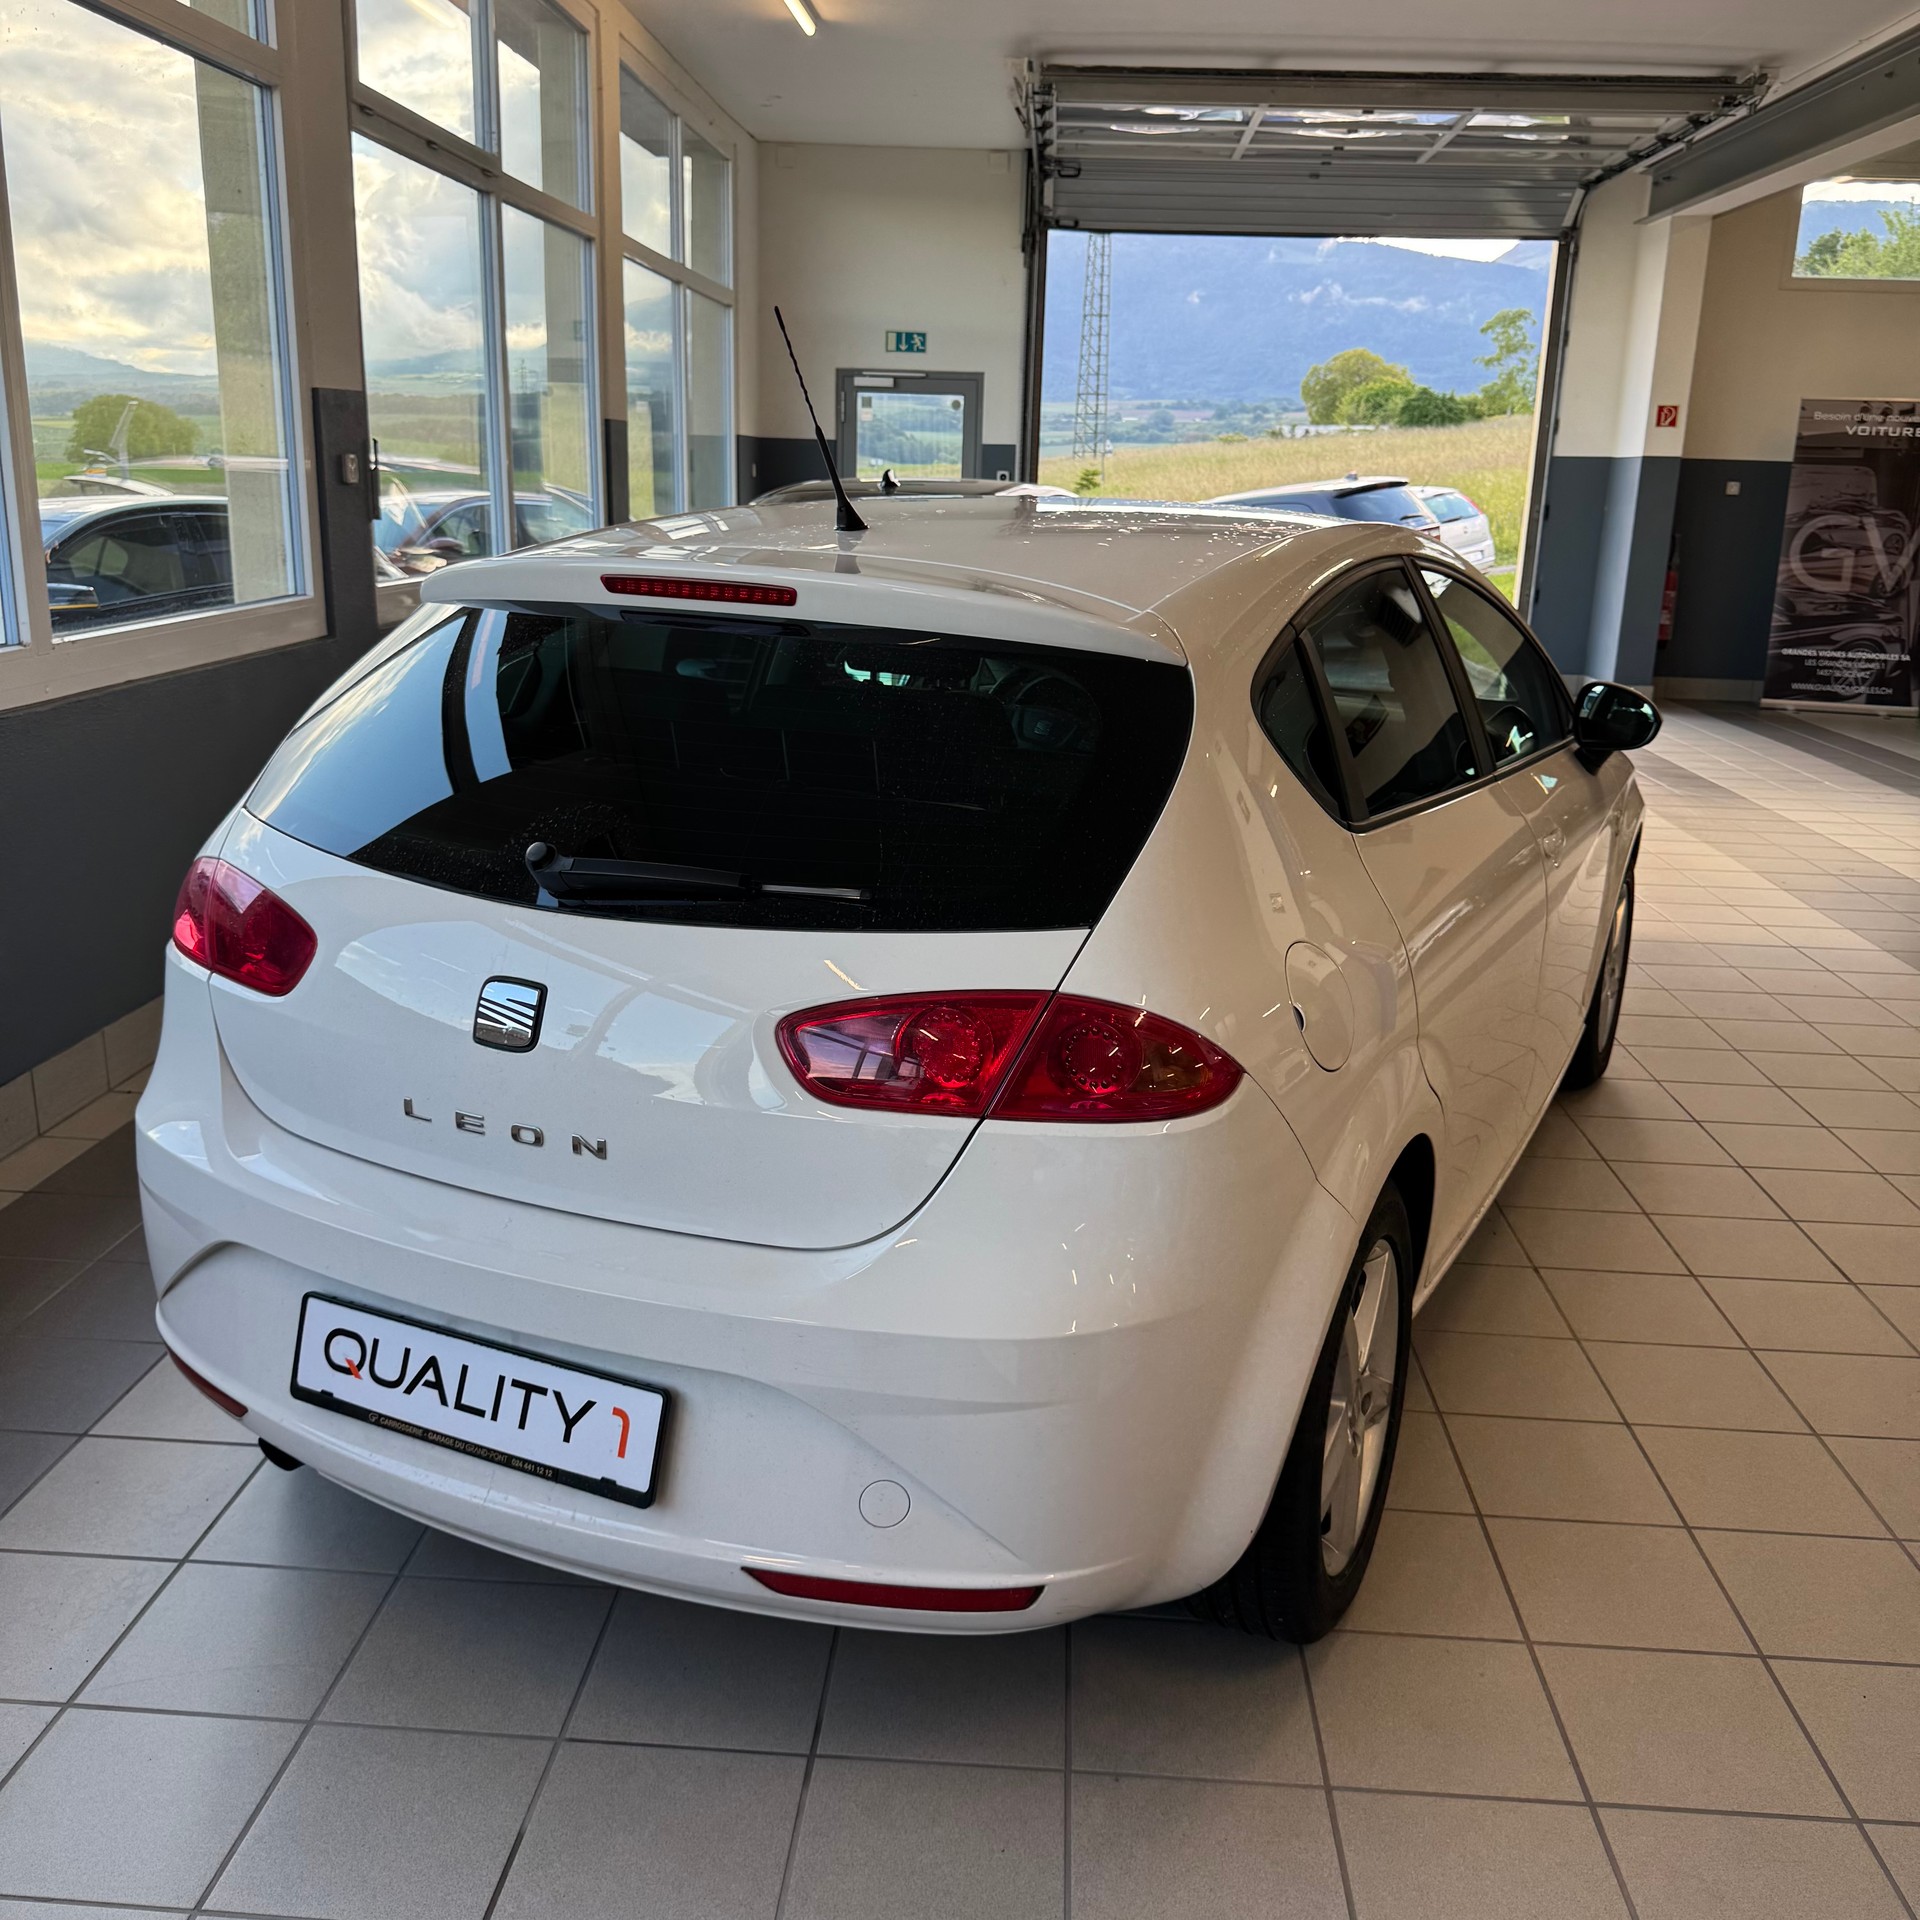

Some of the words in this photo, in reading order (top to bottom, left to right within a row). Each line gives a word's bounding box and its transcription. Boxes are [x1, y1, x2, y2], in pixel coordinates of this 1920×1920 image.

[1814, 411, 1852, 421] Besoin
[403, 1096, 607, 1160] LEON
[323, 1327, 597, 1444] QUALITY
[611, 1406, 631, 1459] 1
[380, 1417, 424, 1436] CARROSSERIE
[427, 1432, 454, 1446] GARAGE
[454, 1440, 466, 1449] DU
[511, 1458, 522, 1468] 024
[523, 1462, 535, 1472] 441
[536, 1466, 544, 1475] 12
[545, 1469, 553, 1478] 12
